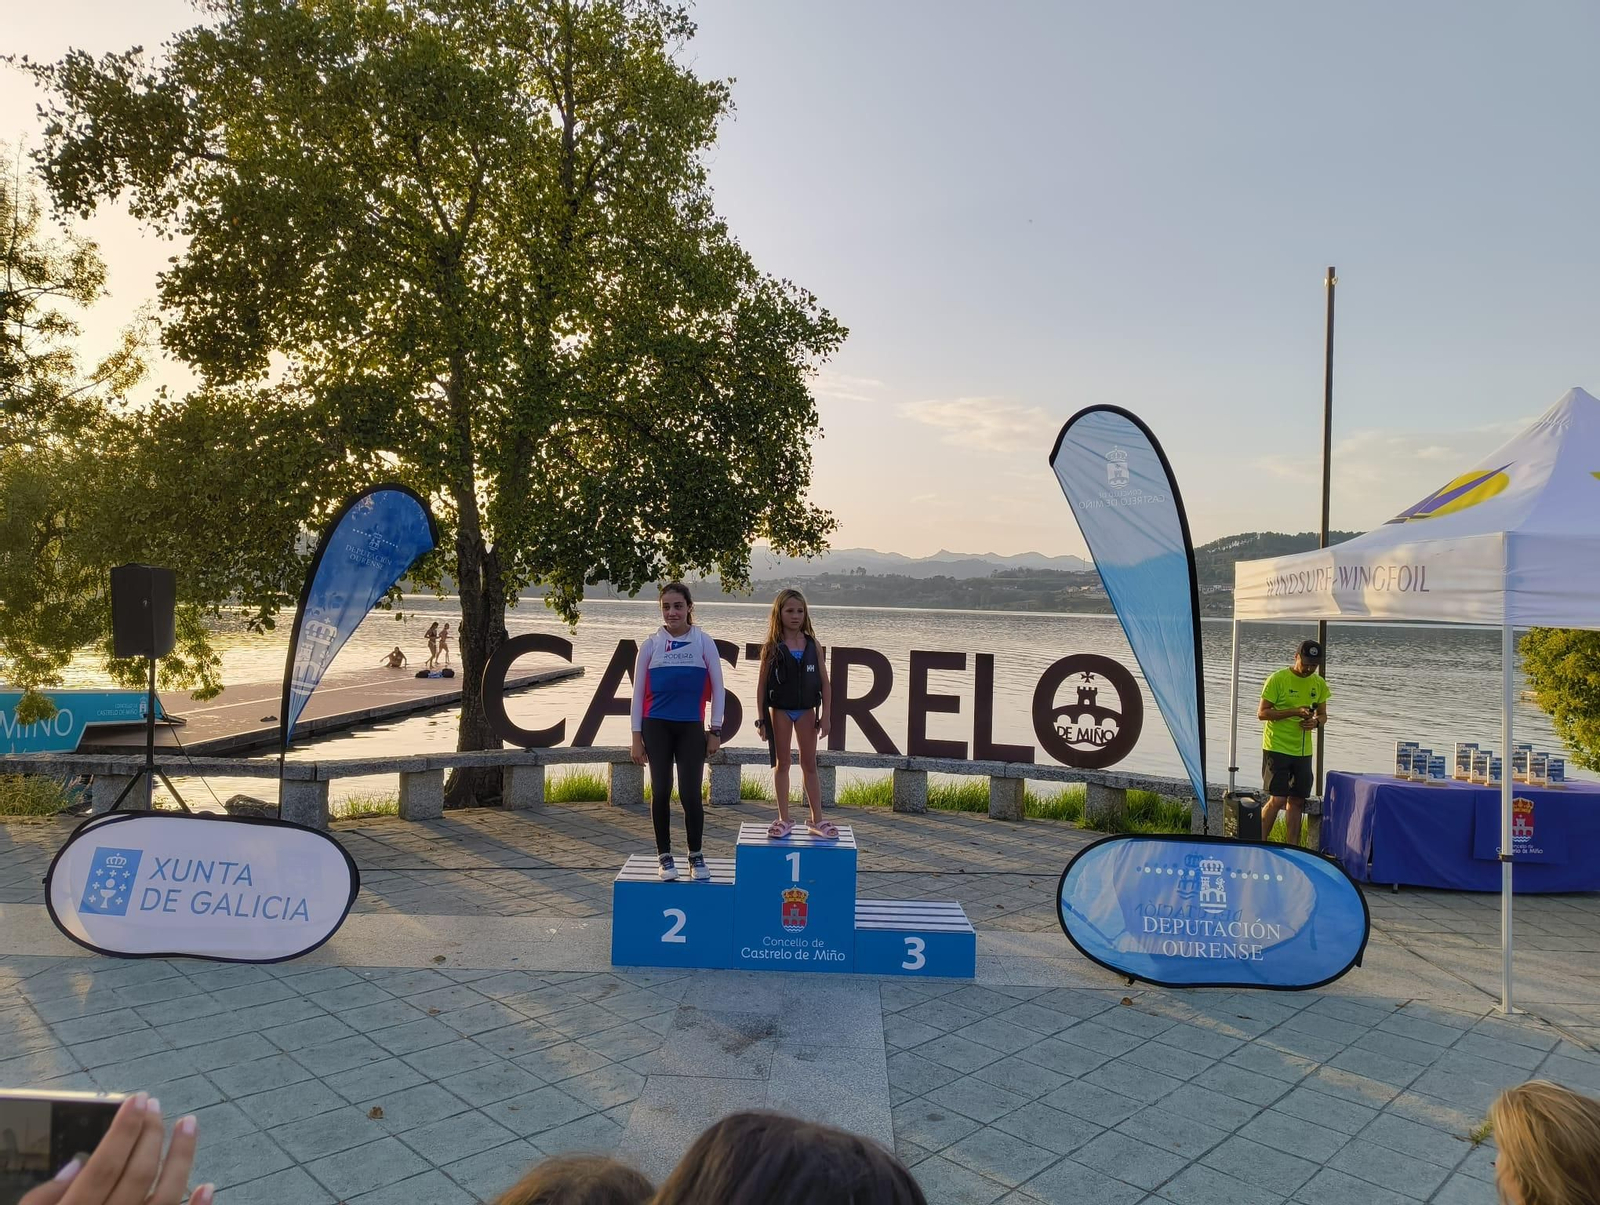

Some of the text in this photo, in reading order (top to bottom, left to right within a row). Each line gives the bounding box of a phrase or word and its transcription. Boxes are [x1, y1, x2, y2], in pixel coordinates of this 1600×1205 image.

[349, 553, 385, 571] OURENSE
[481, 633, 1144, 769] CARELO
[1057, 726, 1115, 743] DE MIÑO
[149, 857, 253, 887] XUNTA
[785, 852, 801, 882] 1
[139, 887, 310, 922] DE GALICIA
[661, 908, 687, 944] 2
[1142, 916, 1281, 940] DEPUTACIÓN
[741, 947, 846, 961] Castrelo de Miño
[762, 936, 825, 948] Concello de
[901, 937, 927, 971] 3
[1162, 940, 1264, 962] OURENSE
